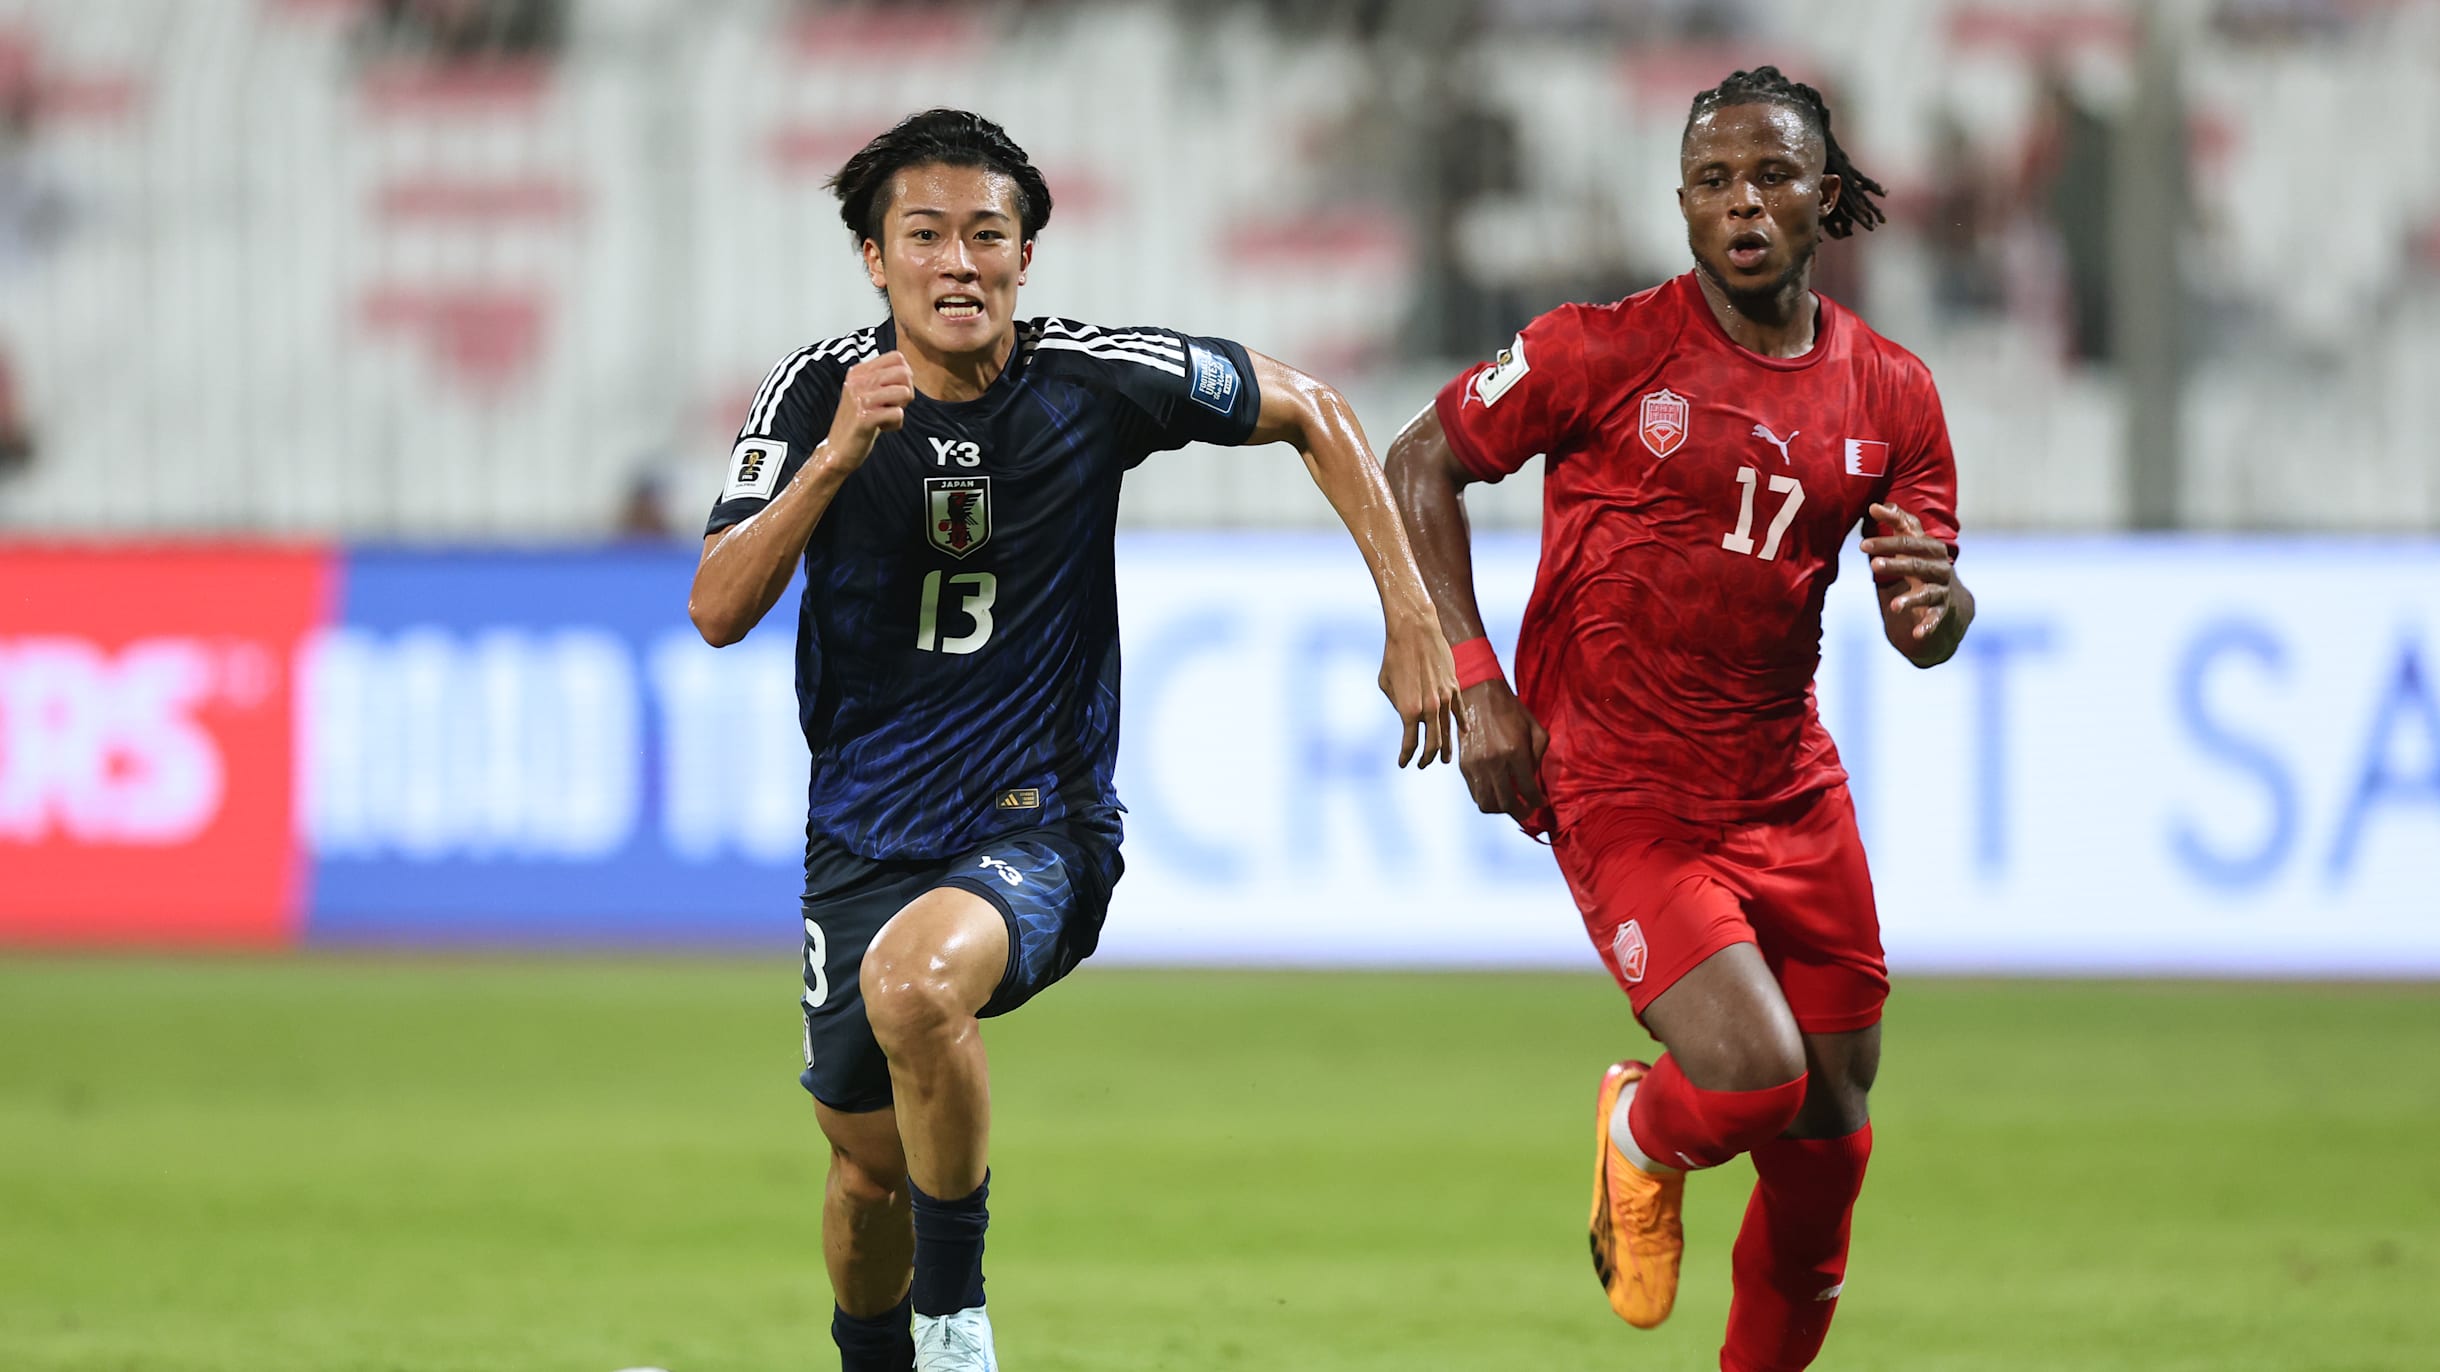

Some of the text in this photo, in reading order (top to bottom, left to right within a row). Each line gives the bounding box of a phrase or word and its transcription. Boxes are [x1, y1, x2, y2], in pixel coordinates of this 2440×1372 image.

[1205, 361, 1218, 396] UNITES
[927, 436, 981, 468] Y-3
[941, 480, 975, 489] JAPAN
[1721, 466, 1806, 562] 17
[916, 569, 997, 655] 13
[0, 632, 228, 846] RS
[1118, 595, 2064, 890] CRIT
[979, 855, 1023, 886] Y-3
[803, 917, 829, 1008] 3
